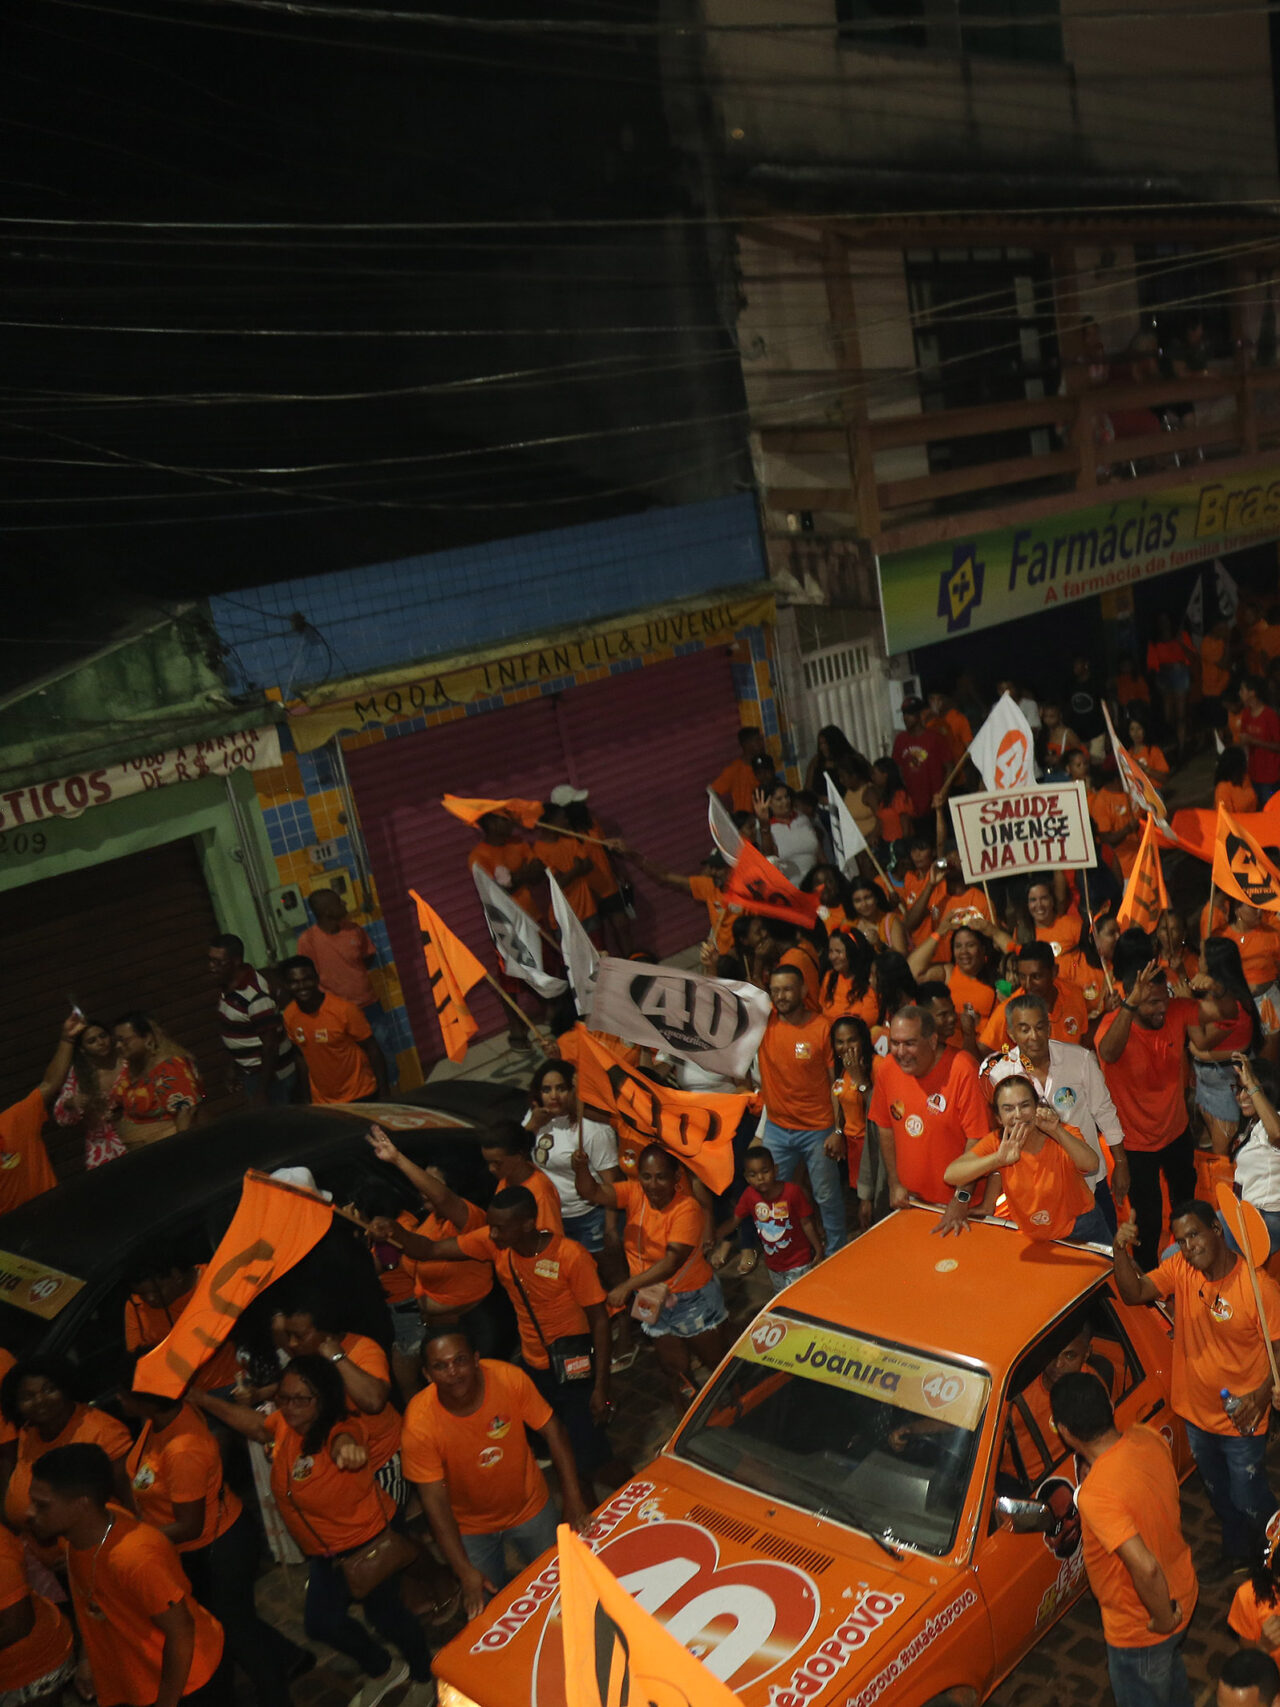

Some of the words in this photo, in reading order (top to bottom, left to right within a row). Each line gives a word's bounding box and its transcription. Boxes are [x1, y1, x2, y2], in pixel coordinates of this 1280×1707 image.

[1008, 499, 1180, 591] Farmácias
[1043, 585, 1059, 604] A
[1145, 554, 1167, 575] da
[353, 679, 450, 722] MODA
[483, 634, 619, 689] INFANTIL
[640, 605, 739, 648] JUVENIL
[176, 748, 188, 762] A
[981, 815, 1071, 847] UNENSE
[980, 848, 1017, 873] NA
[1024, 837, 1068, 864] UTI
[641, 974, 741, 1050] 40
[614, 1075, 714, 1160] 40
[30, 1278, 58, 1301] 40
[751, 1324, 783, 1348] 40
[794, 1341, 902, 1393] Joanira
[922, 1375, 961, 1401] 40
